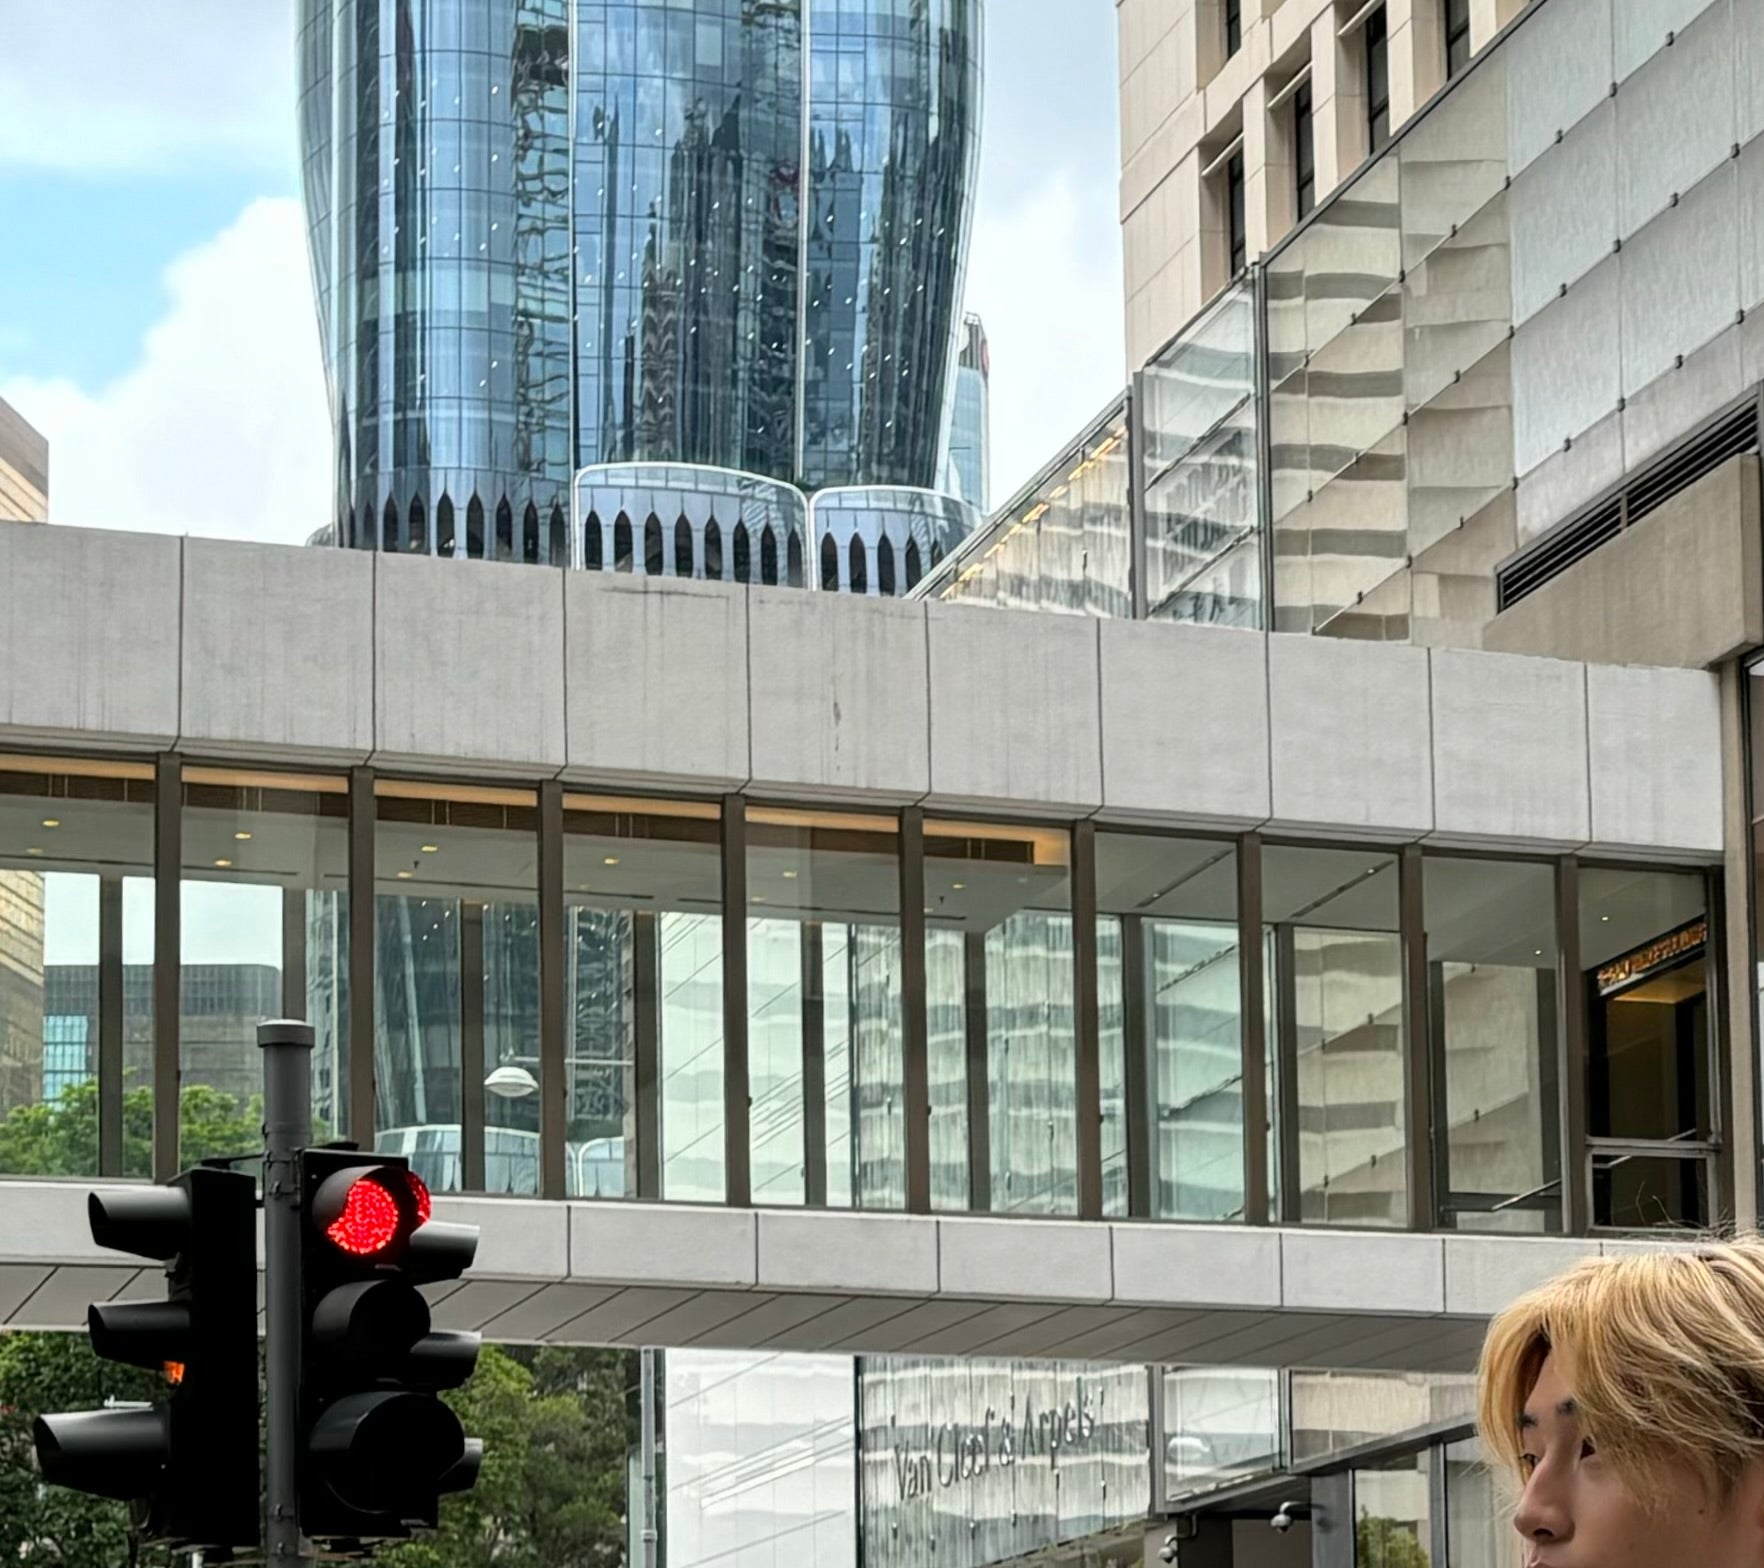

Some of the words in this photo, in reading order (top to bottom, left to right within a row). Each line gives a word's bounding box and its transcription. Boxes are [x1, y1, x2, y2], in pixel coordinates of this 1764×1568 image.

[893, 1440, 932, 1500] Van
[936, 1405, 995, 1488] Cleef
[1021, 1376, 1095, 1472] Arpels
